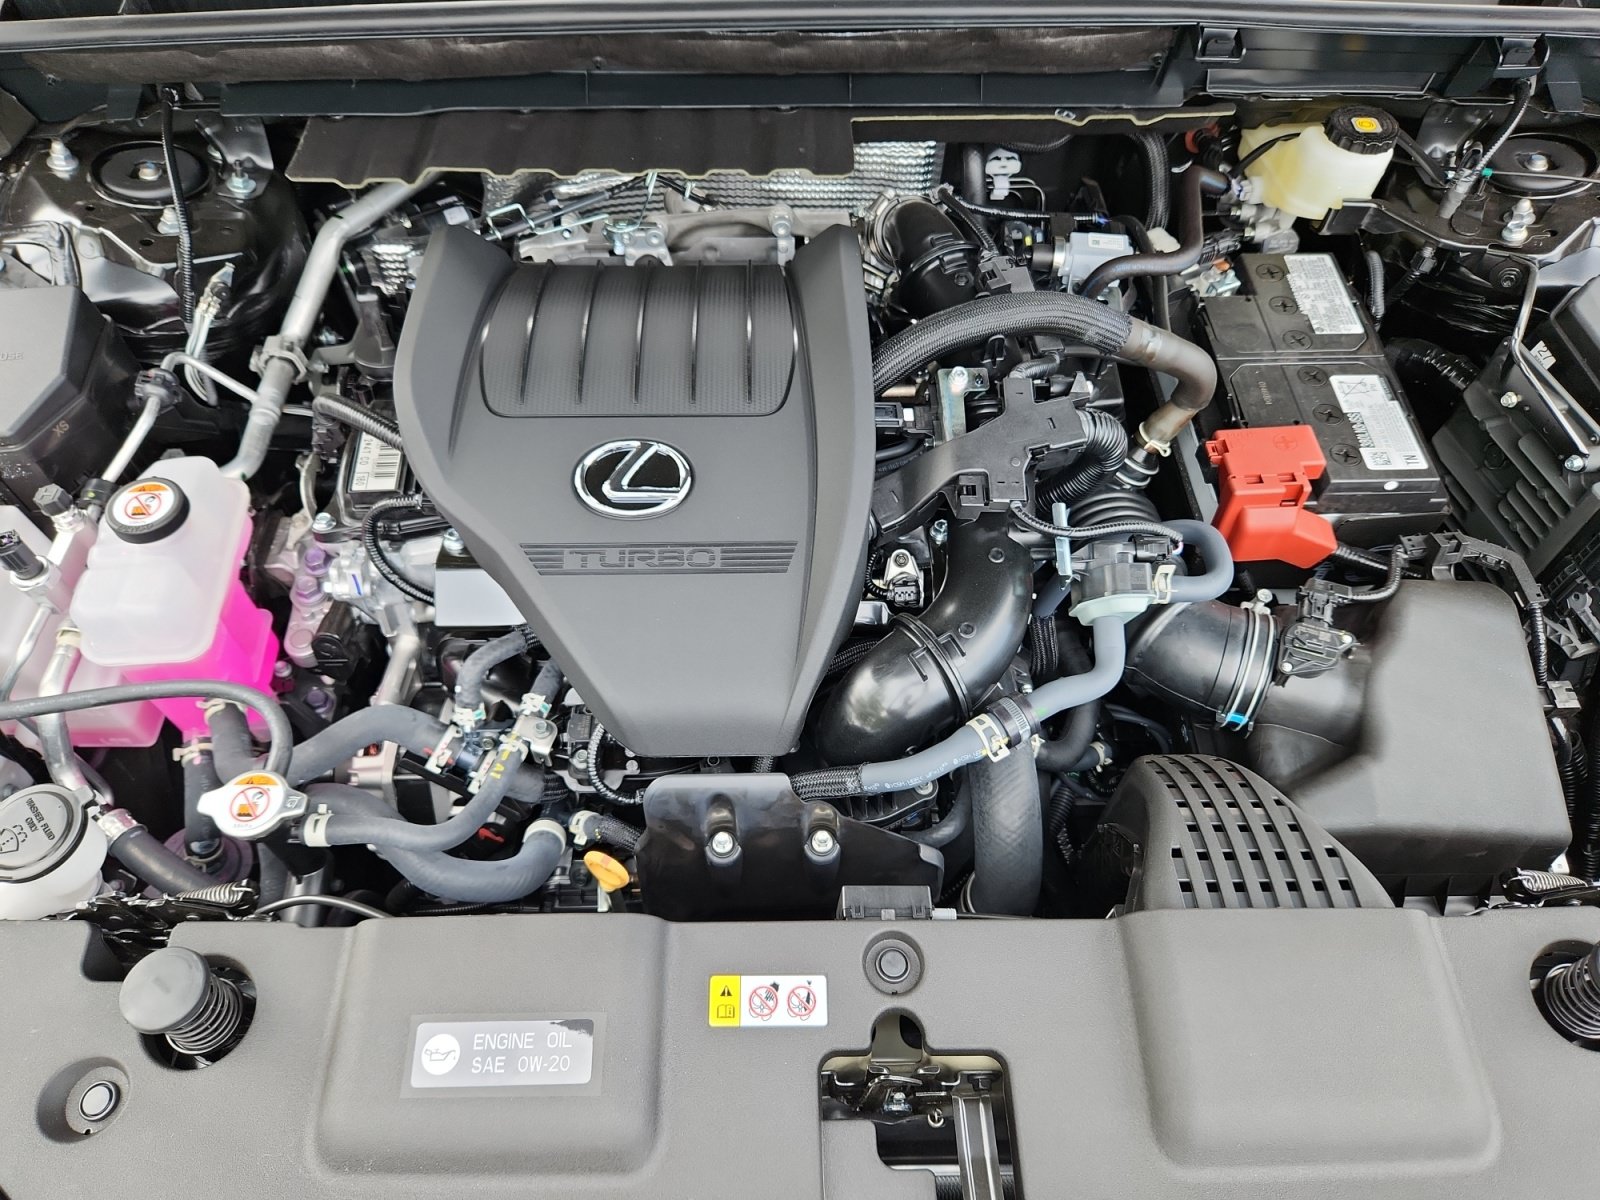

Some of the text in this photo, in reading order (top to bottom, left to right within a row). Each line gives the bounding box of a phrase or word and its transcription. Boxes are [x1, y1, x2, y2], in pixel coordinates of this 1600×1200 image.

[568, 547, 717, 569] TURBO
[25, 816, 40, 832] ONLY
[26, 797, 56, 841] WASHER FLUID
[473, 1031, 573, 1050] ENGINE OIL
[471, 1055, 570, 1074] SAE 0W-20
